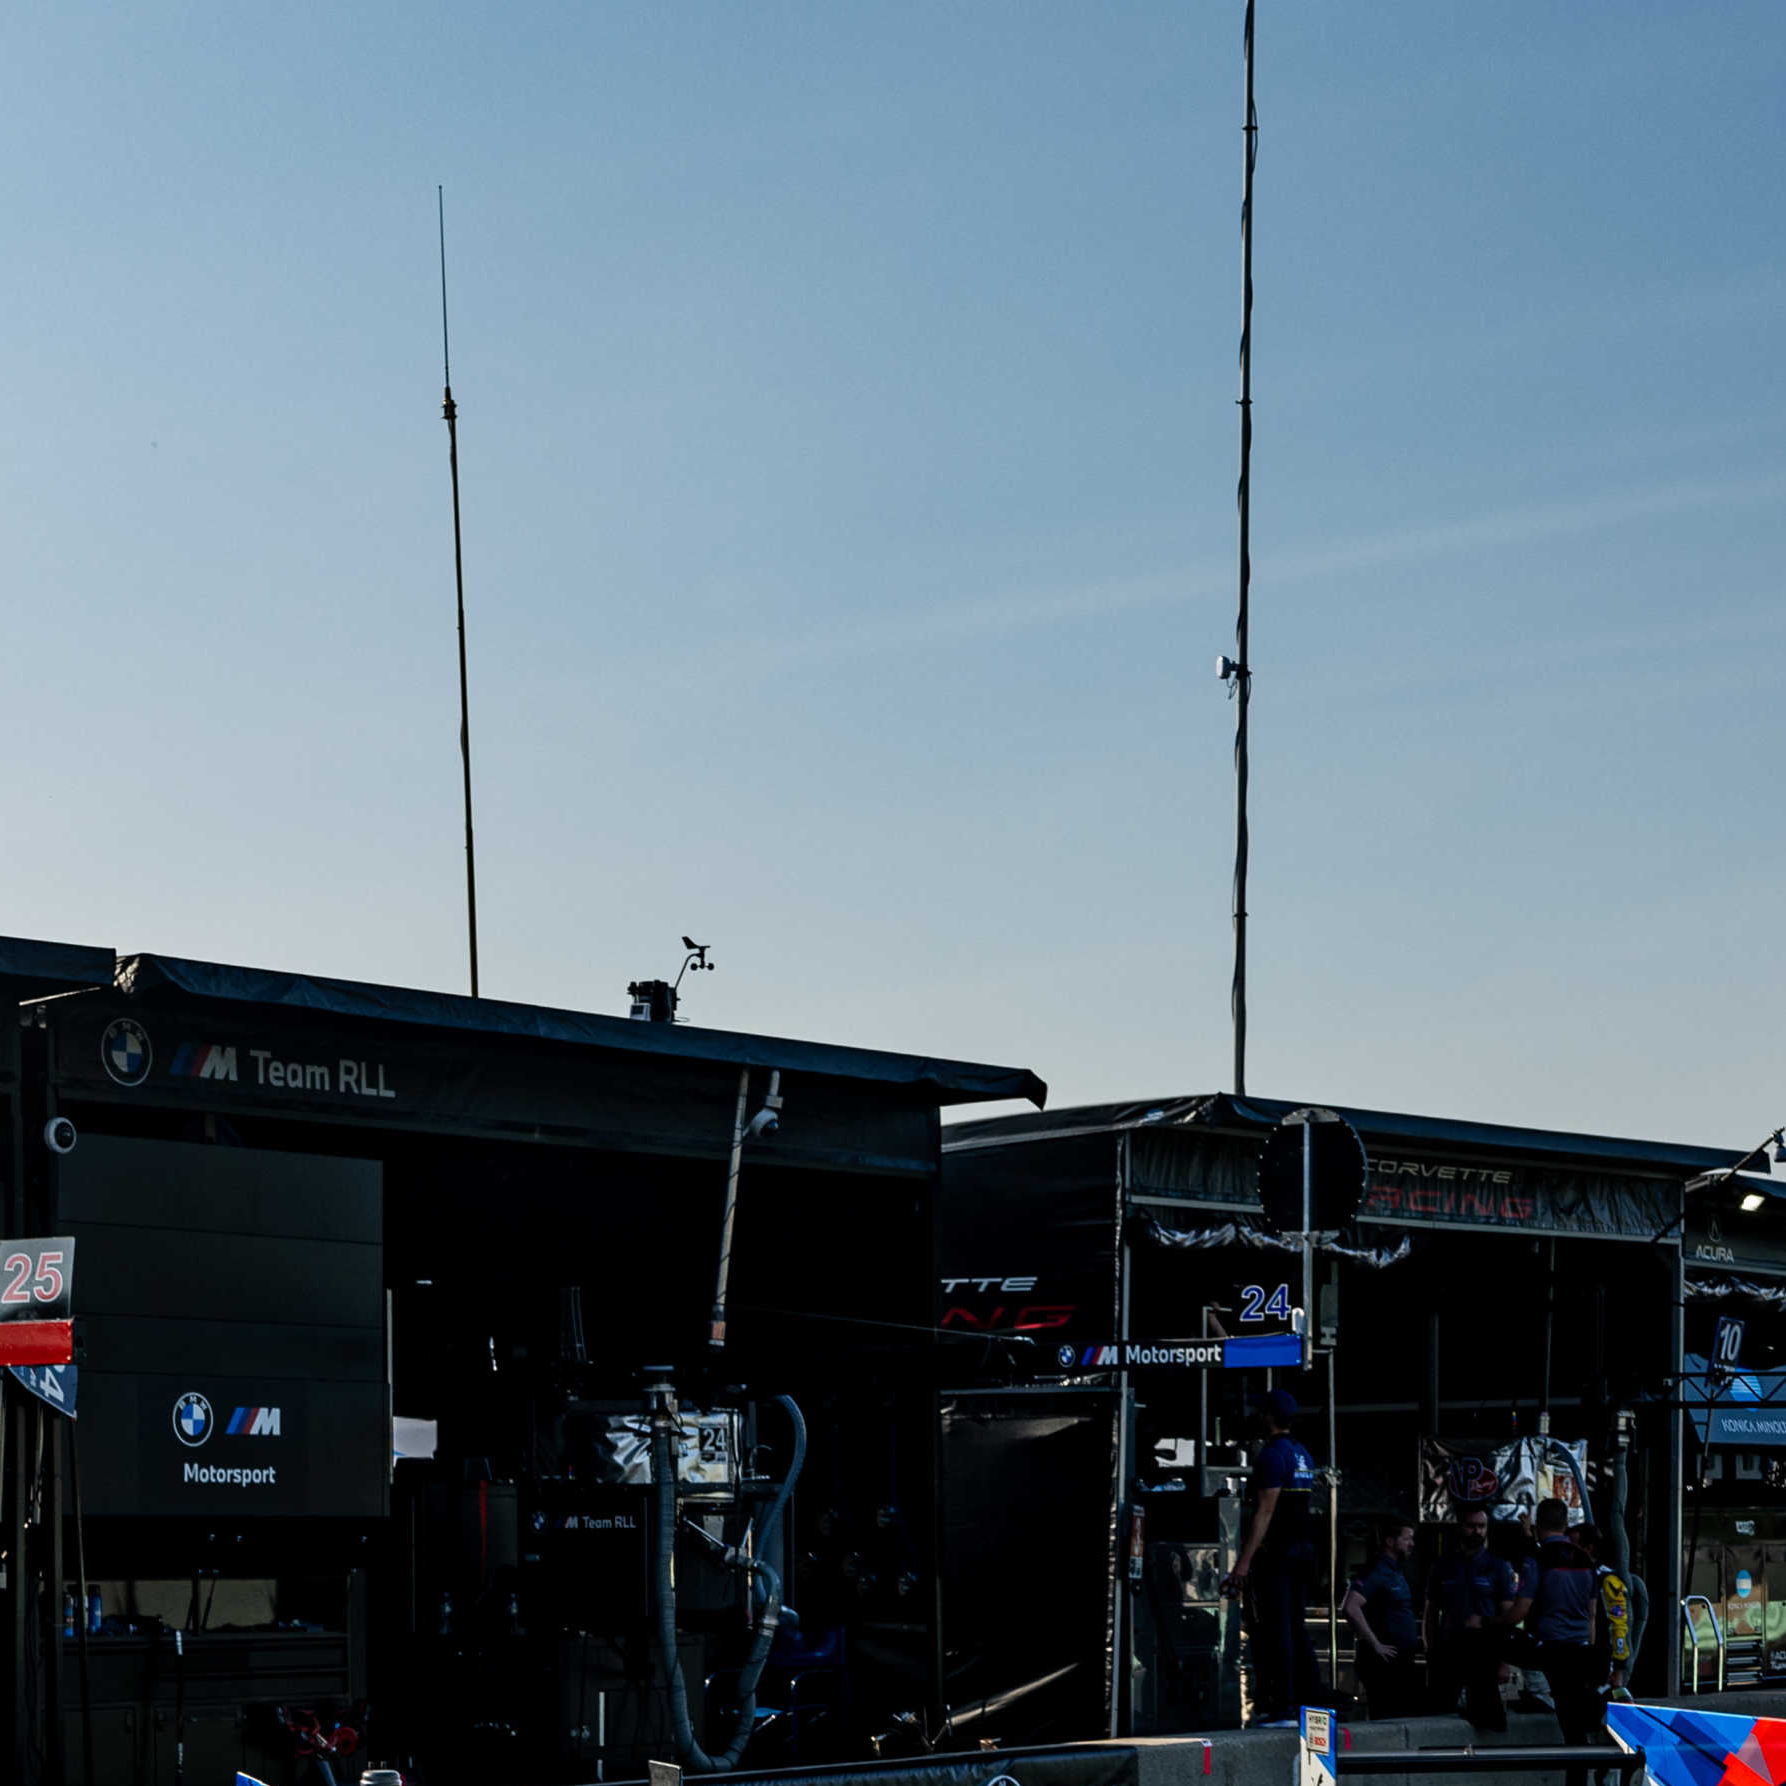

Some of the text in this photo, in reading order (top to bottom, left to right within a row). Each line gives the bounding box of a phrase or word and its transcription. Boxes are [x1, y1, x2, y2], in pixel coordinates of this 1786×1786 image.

[250, 1048, 332, 1095] Team
[340, 1061, 396, 1099] RLL
[1368, 1186, 1535, 1218] ACING
[1695, 1245, 1734, 1263] ACURA
[1, 1252, 65, 1305] 25
[1239, 1284, 1291, 1322] 24
[1720, 1322, 1742, 1361] 10
[1125, 1344, 1222, 1367] Motorsport
[1720, 1418, 1755, 1433] KONICA
[703, 1429, 727, 1451] 24
[183, 1462, 277, 1487] Motorsport
[582, 1517, 612, 1528] Team
[615, 1517, 636, 1528] RLL
